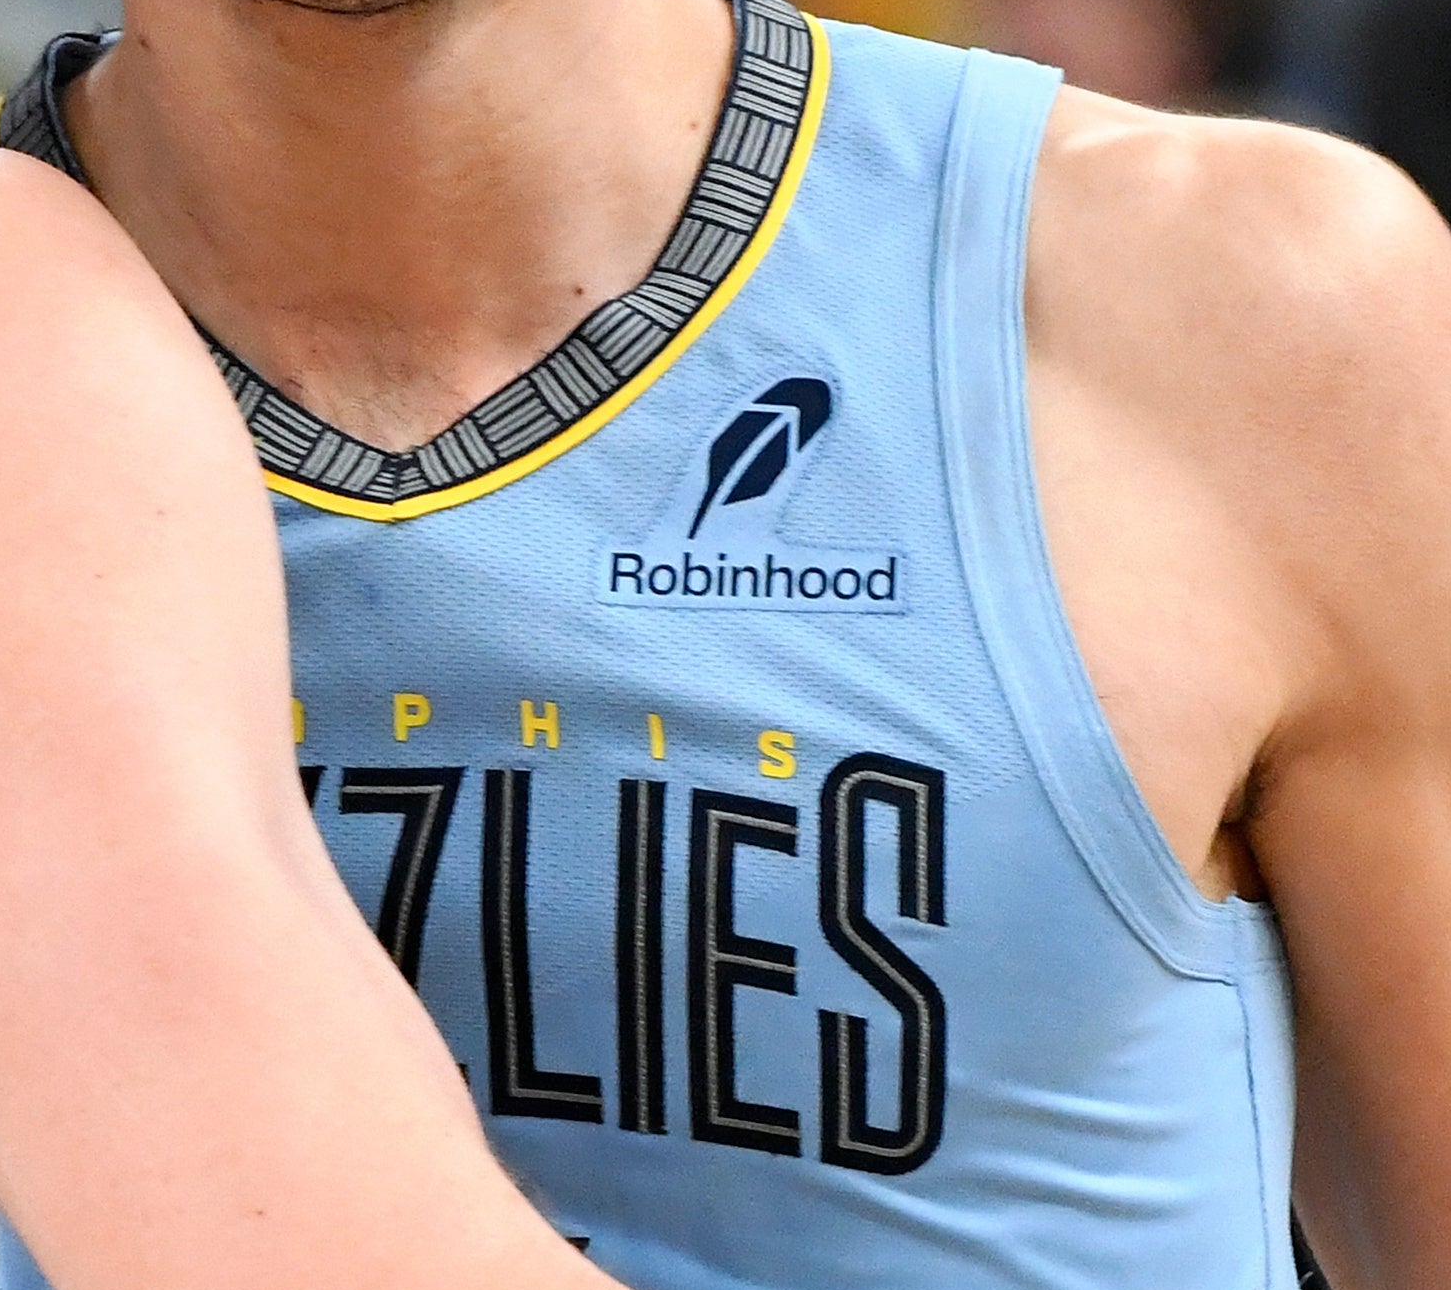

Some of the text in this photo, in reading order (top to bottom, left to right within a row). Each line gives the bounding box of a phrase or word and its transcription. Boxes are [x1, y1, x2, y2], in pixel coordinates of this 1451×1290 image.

[609, 551, 898, 601] Robinhood
[291, 692, 798, 781] PHIS
[297, 750, 947, 1177] ZLIES
